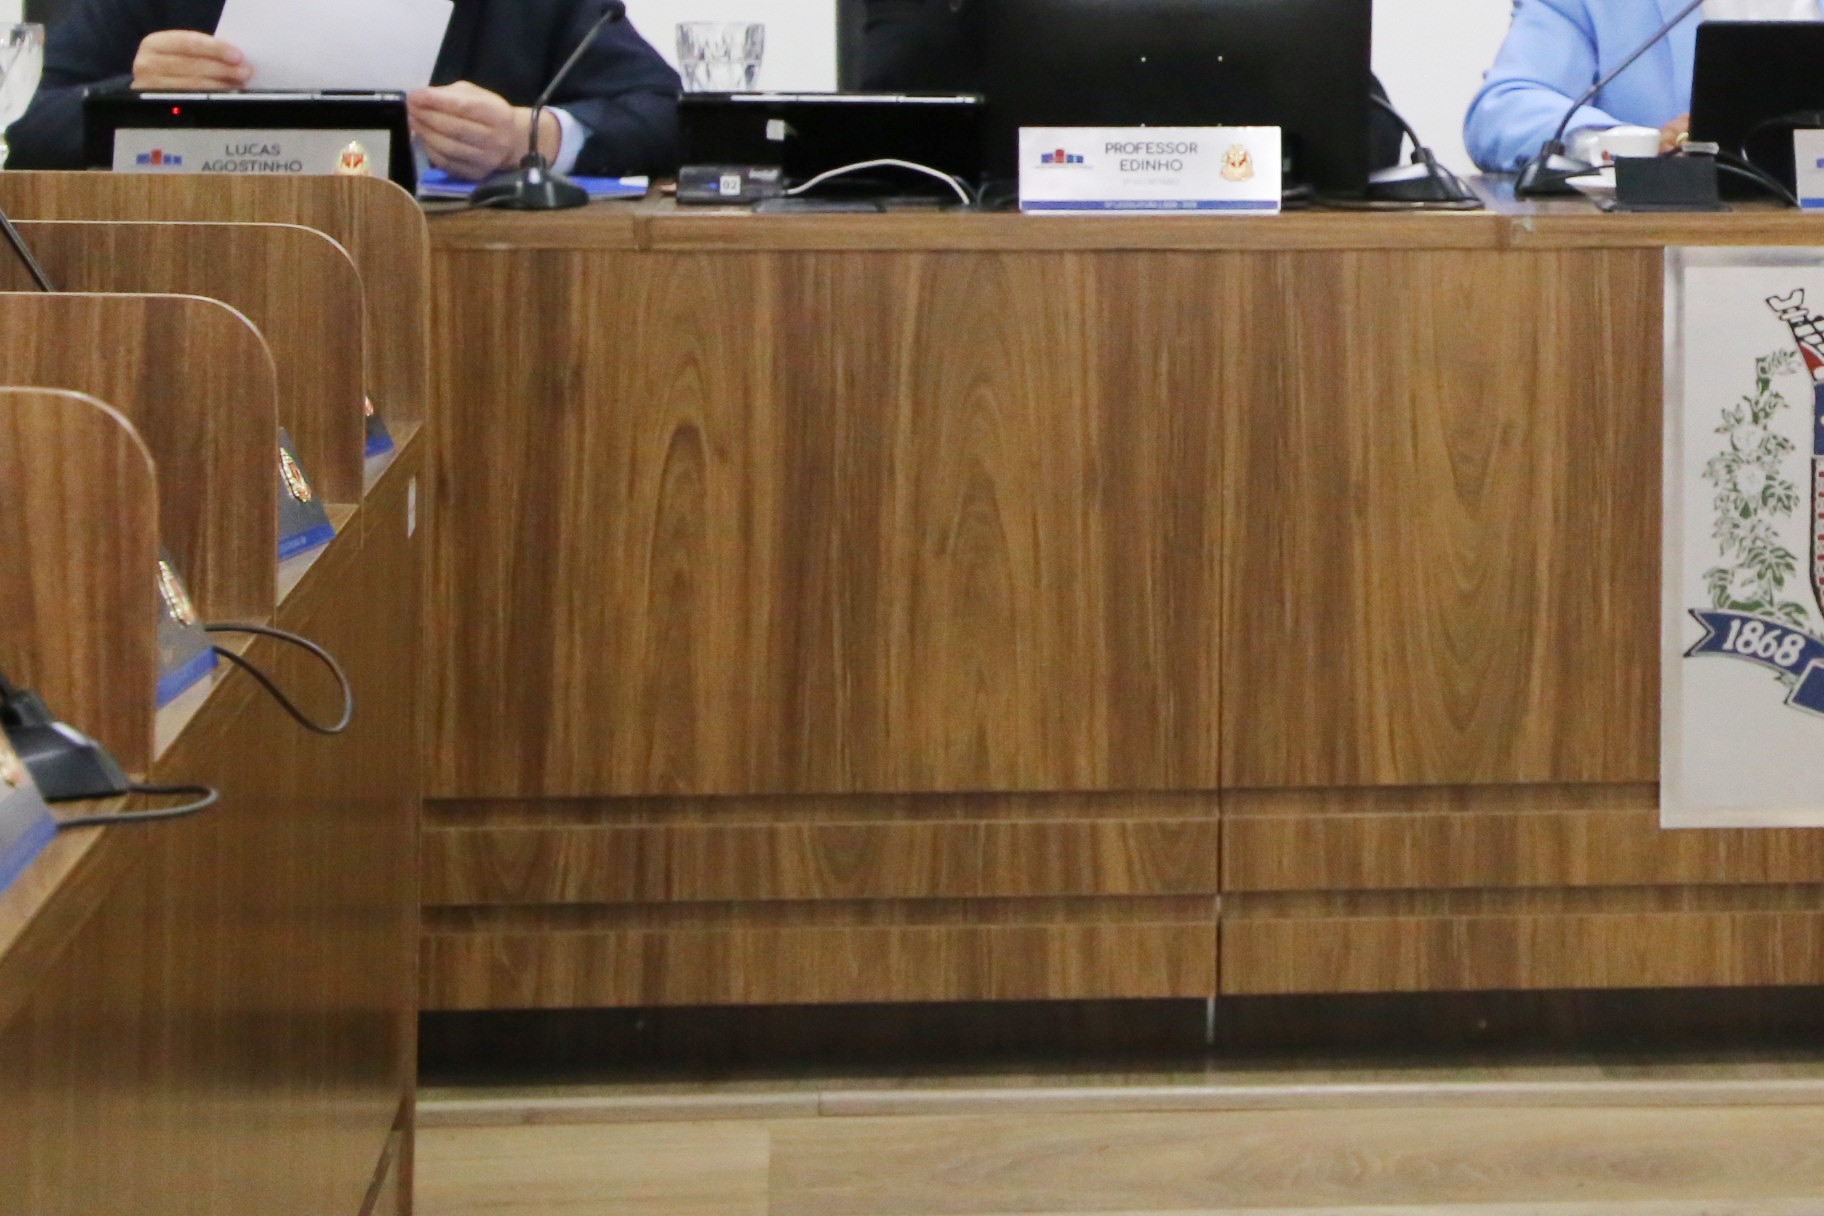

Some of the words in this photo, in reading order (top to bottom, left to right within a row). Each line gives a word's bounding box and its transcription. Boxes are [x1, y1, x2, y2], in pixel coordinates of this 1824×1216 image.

[225, 144, 281, 157] LUCAS
[1104, 141, 1199, 155] PROFESSOR
[202, 160, 303, 172] AGOSTINHO
[1119, 159, 1184, 172] EDINHO
[1723, 618, 1805, 667] 1868
